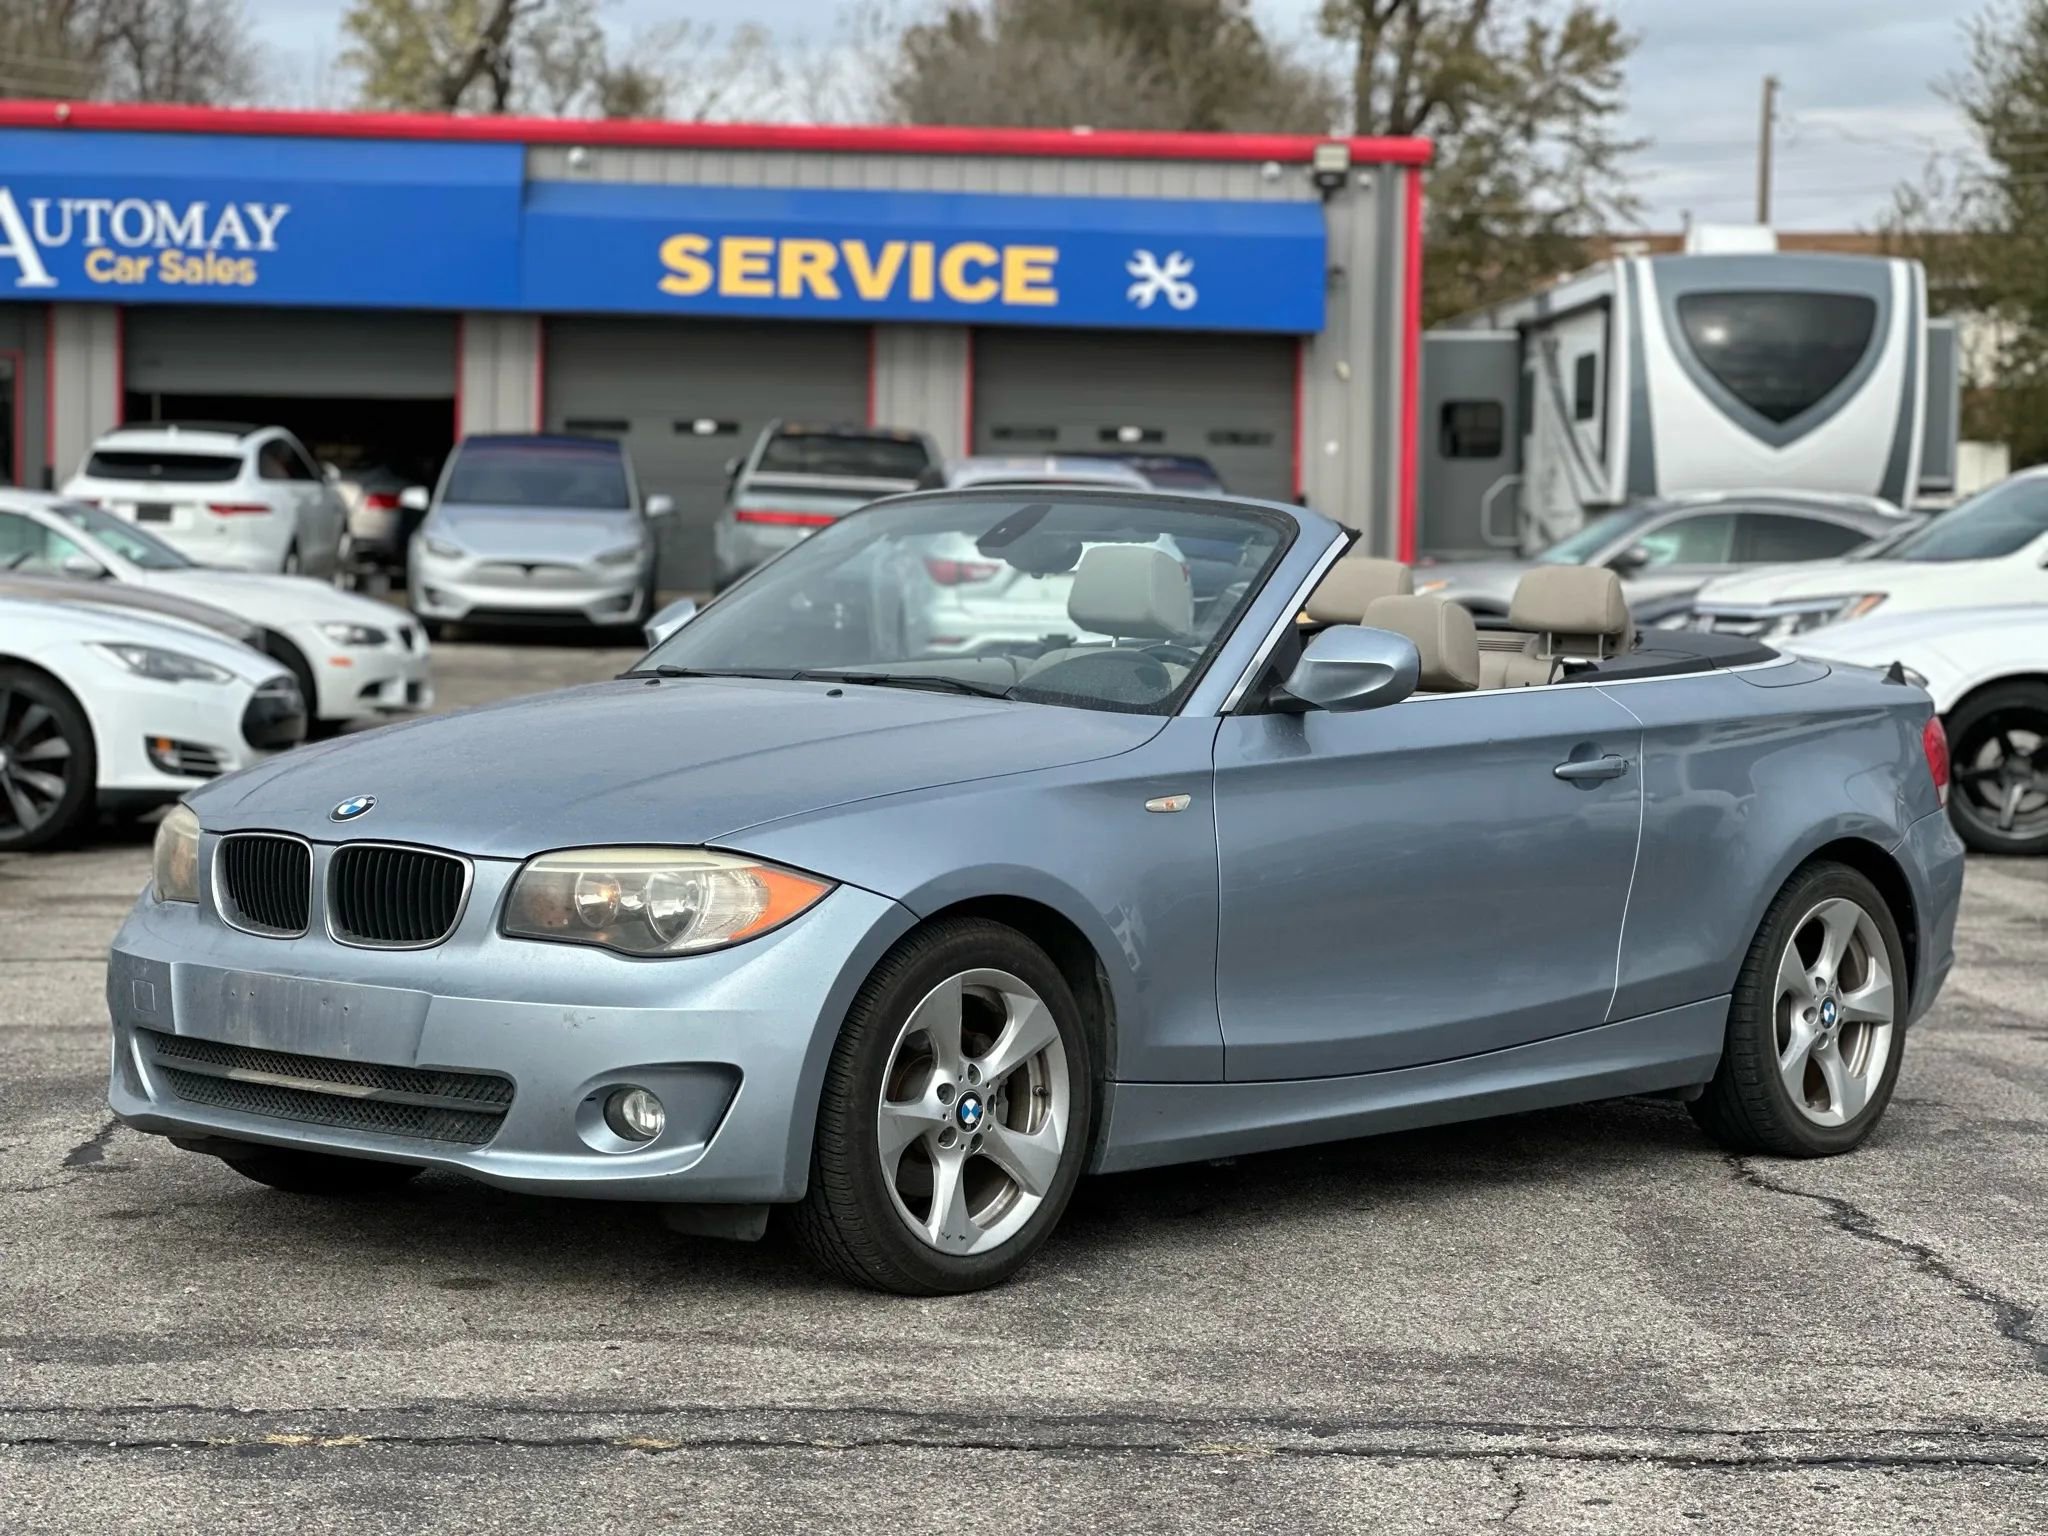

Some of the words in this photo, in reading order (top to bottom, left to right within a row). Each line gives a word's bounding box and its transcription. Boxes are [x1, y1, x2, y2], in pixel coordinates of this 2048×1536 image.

[0, 185, 290, 288] AUTOMAY
[84, 247, 152, 284] Car
[158, 248, 258, 286] Sales
[659, 234, 1059, 306] SERVICE
